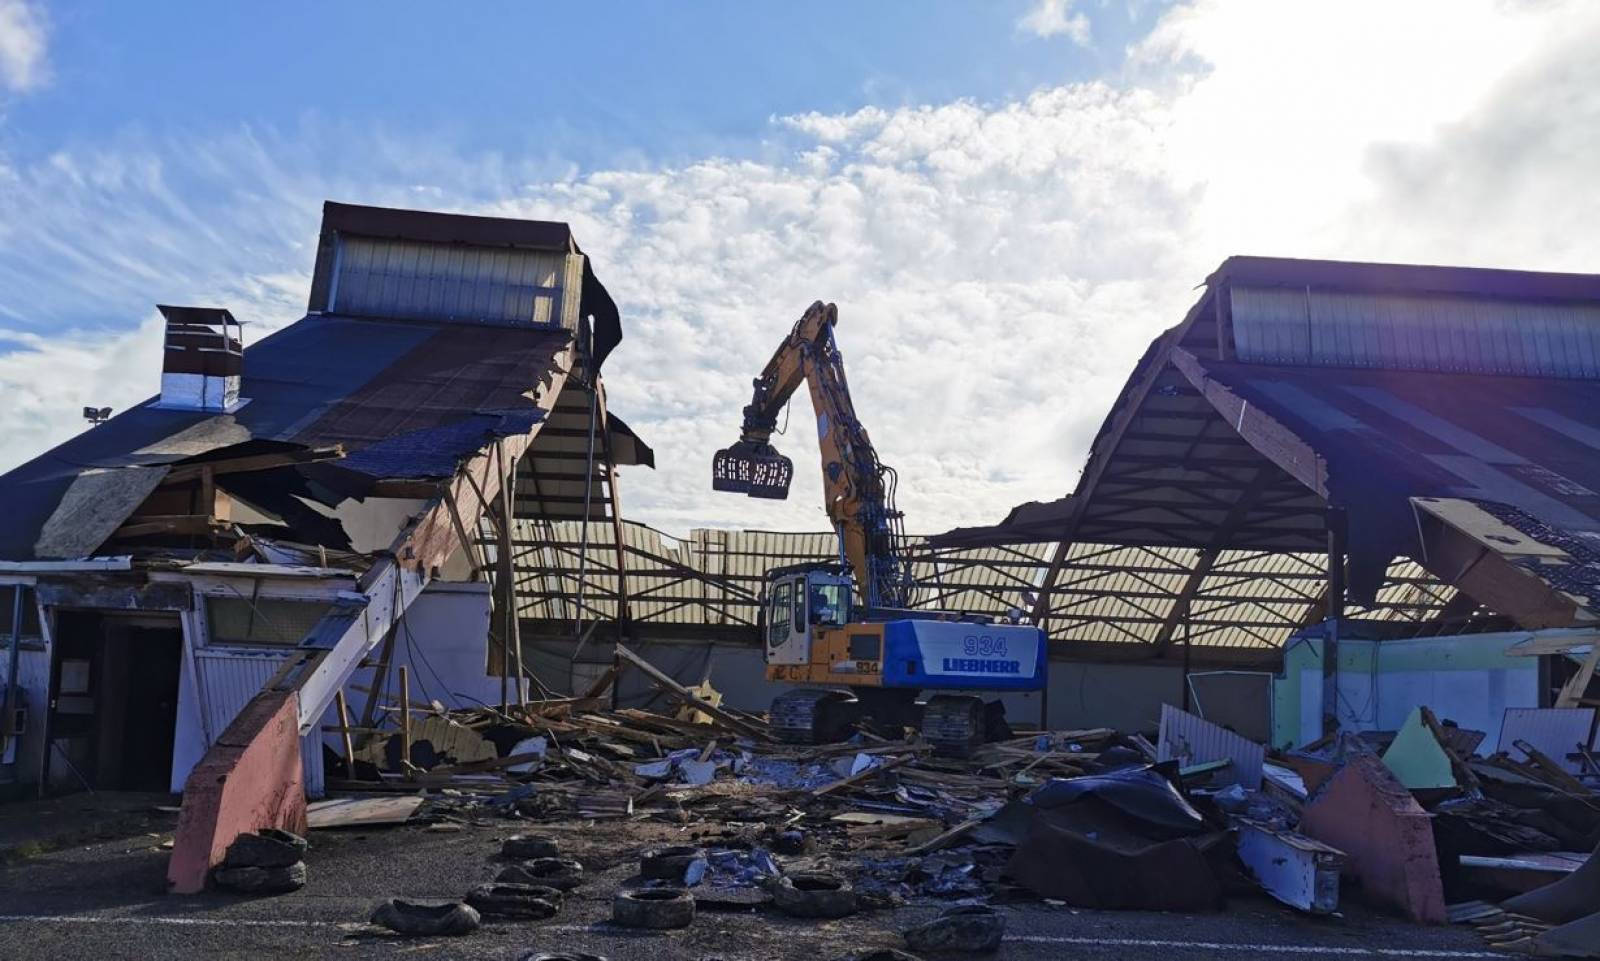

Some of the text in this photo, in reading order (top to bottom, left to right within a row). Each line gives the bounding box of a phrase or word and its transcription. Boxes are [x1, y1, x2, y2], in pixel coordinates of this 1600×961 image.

[963, 635, 1008, 657] 934
[855, 661, 879, 674] 934
[942, 657, 1021, 674] LIEBHERR
